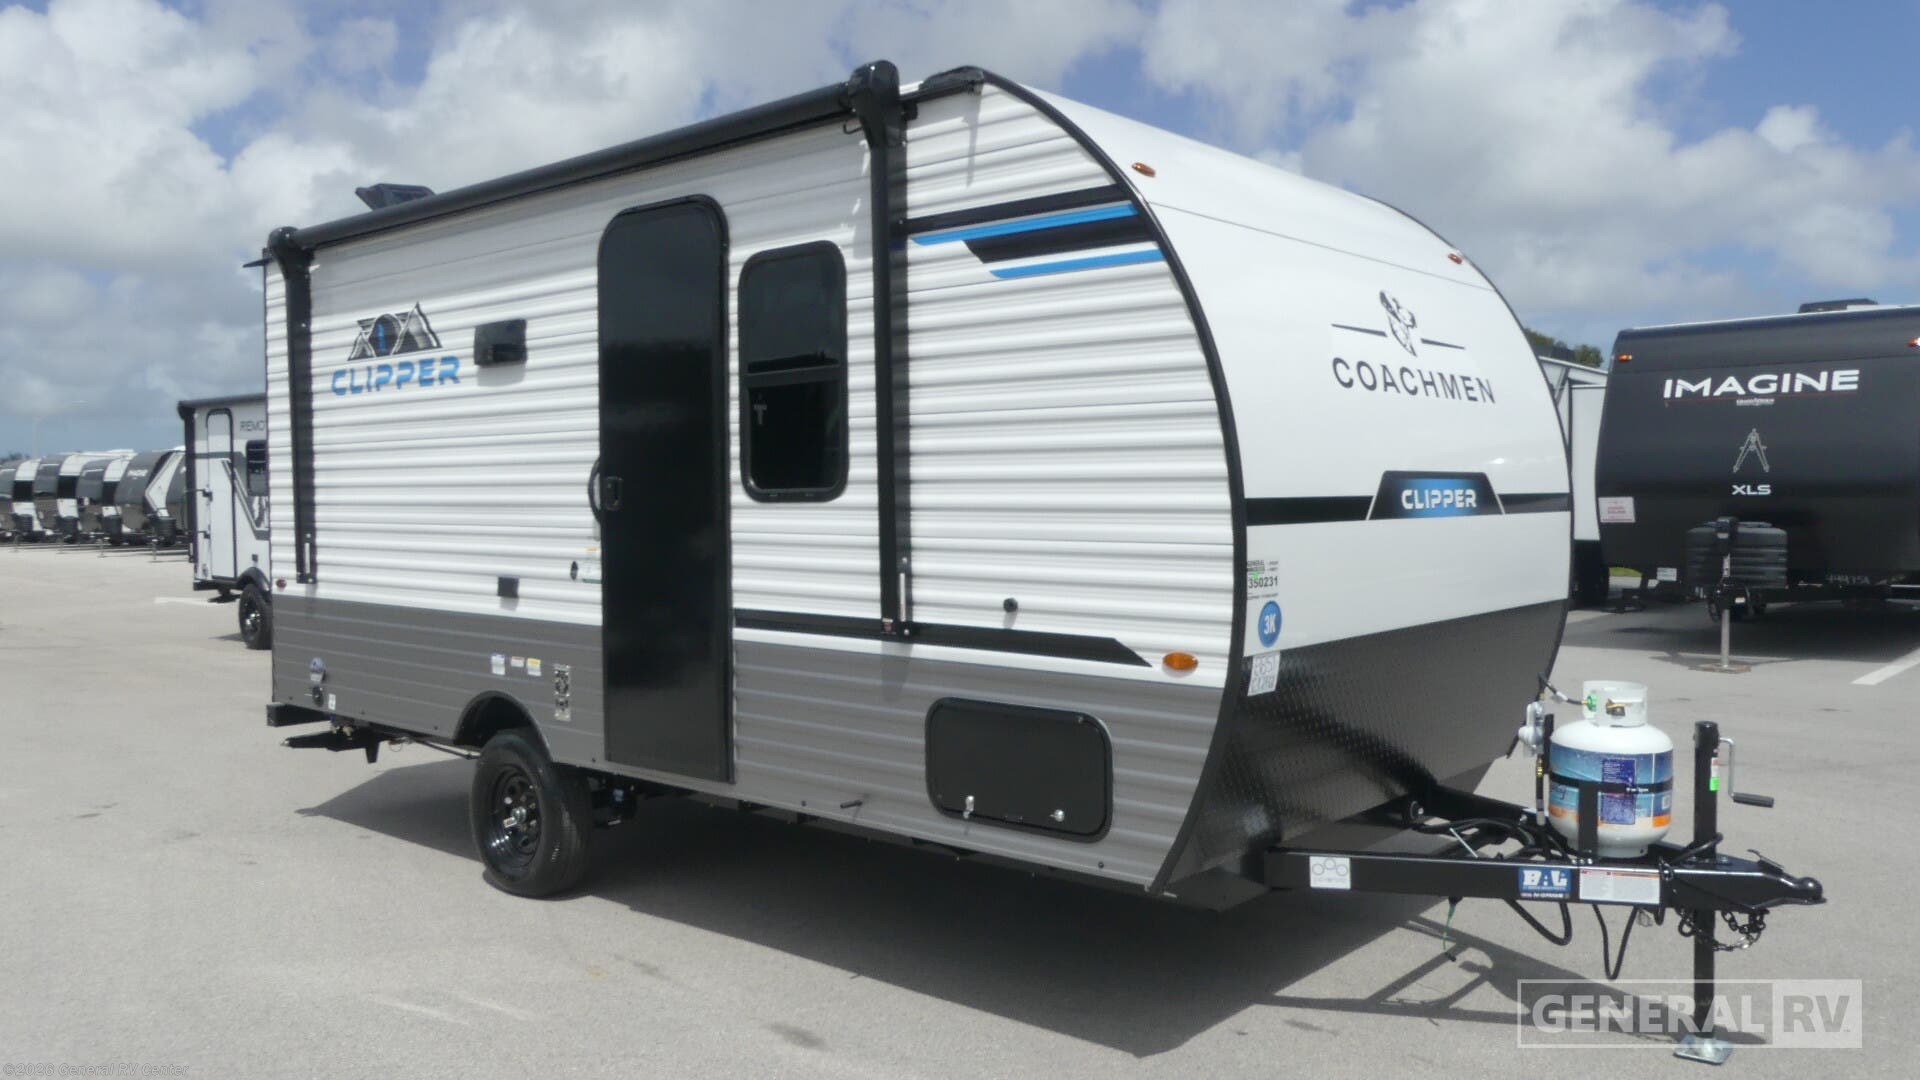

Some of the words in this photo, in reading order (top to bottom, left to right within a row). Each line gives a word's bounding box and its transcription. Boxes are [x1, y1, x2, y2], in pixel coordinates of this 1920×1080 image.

[331, 355, 461, 396] CLIPPER
[1332, 357, 1496, 404] COACHMEN
[1662, 369, 1860, 399] IMAGINE
[1401, 489, 1477, 510] CLIPPER
[1732, 485, 1771, 495] XLS
[1263, 614, 1276, 635] 3K
